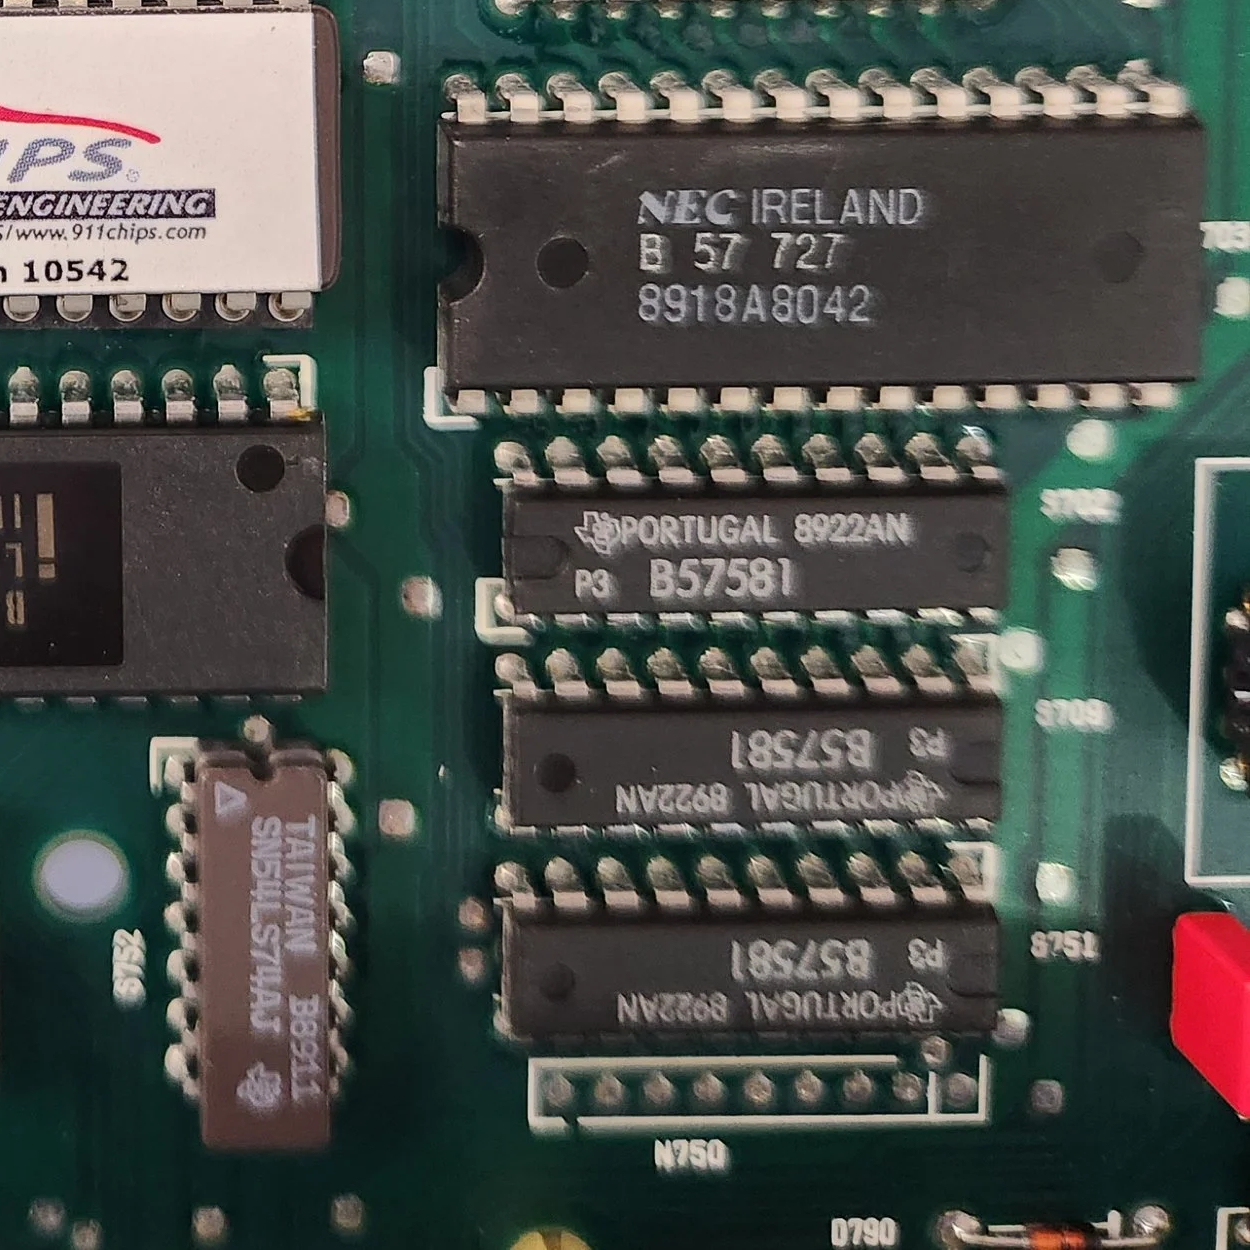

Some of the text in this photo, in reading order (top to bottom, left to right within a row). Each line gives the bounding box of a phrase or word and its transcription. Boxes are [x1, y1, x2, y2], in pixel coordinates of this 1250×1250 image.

[636, 188, 924, 227] NEC IRELAND
[23, 259, 129, 284] 10542
[638, 233, 845, 272] B 57 727
[637, 285, 875, 324] 8918A8042
[620, 513, 911, 546] PORTUGAL 8922AN
[574, 559, 794, 600] P3 B57581
[5, 589, 25, 626] B
[730, 727, 947, 771] P3 B57581
[614, 781, 895, 815] PORTUGAL 8922AN
[249, 815, 283, 1033] SN54LS74AJ
[284, 813, 322, 1101] TAIWAN B8911
[730, 938, 946, 980] P3 B57581
[616, 989, 896, 1023] PORTUGAL 8922AN
[653, 1139, 731, 1171] N750
